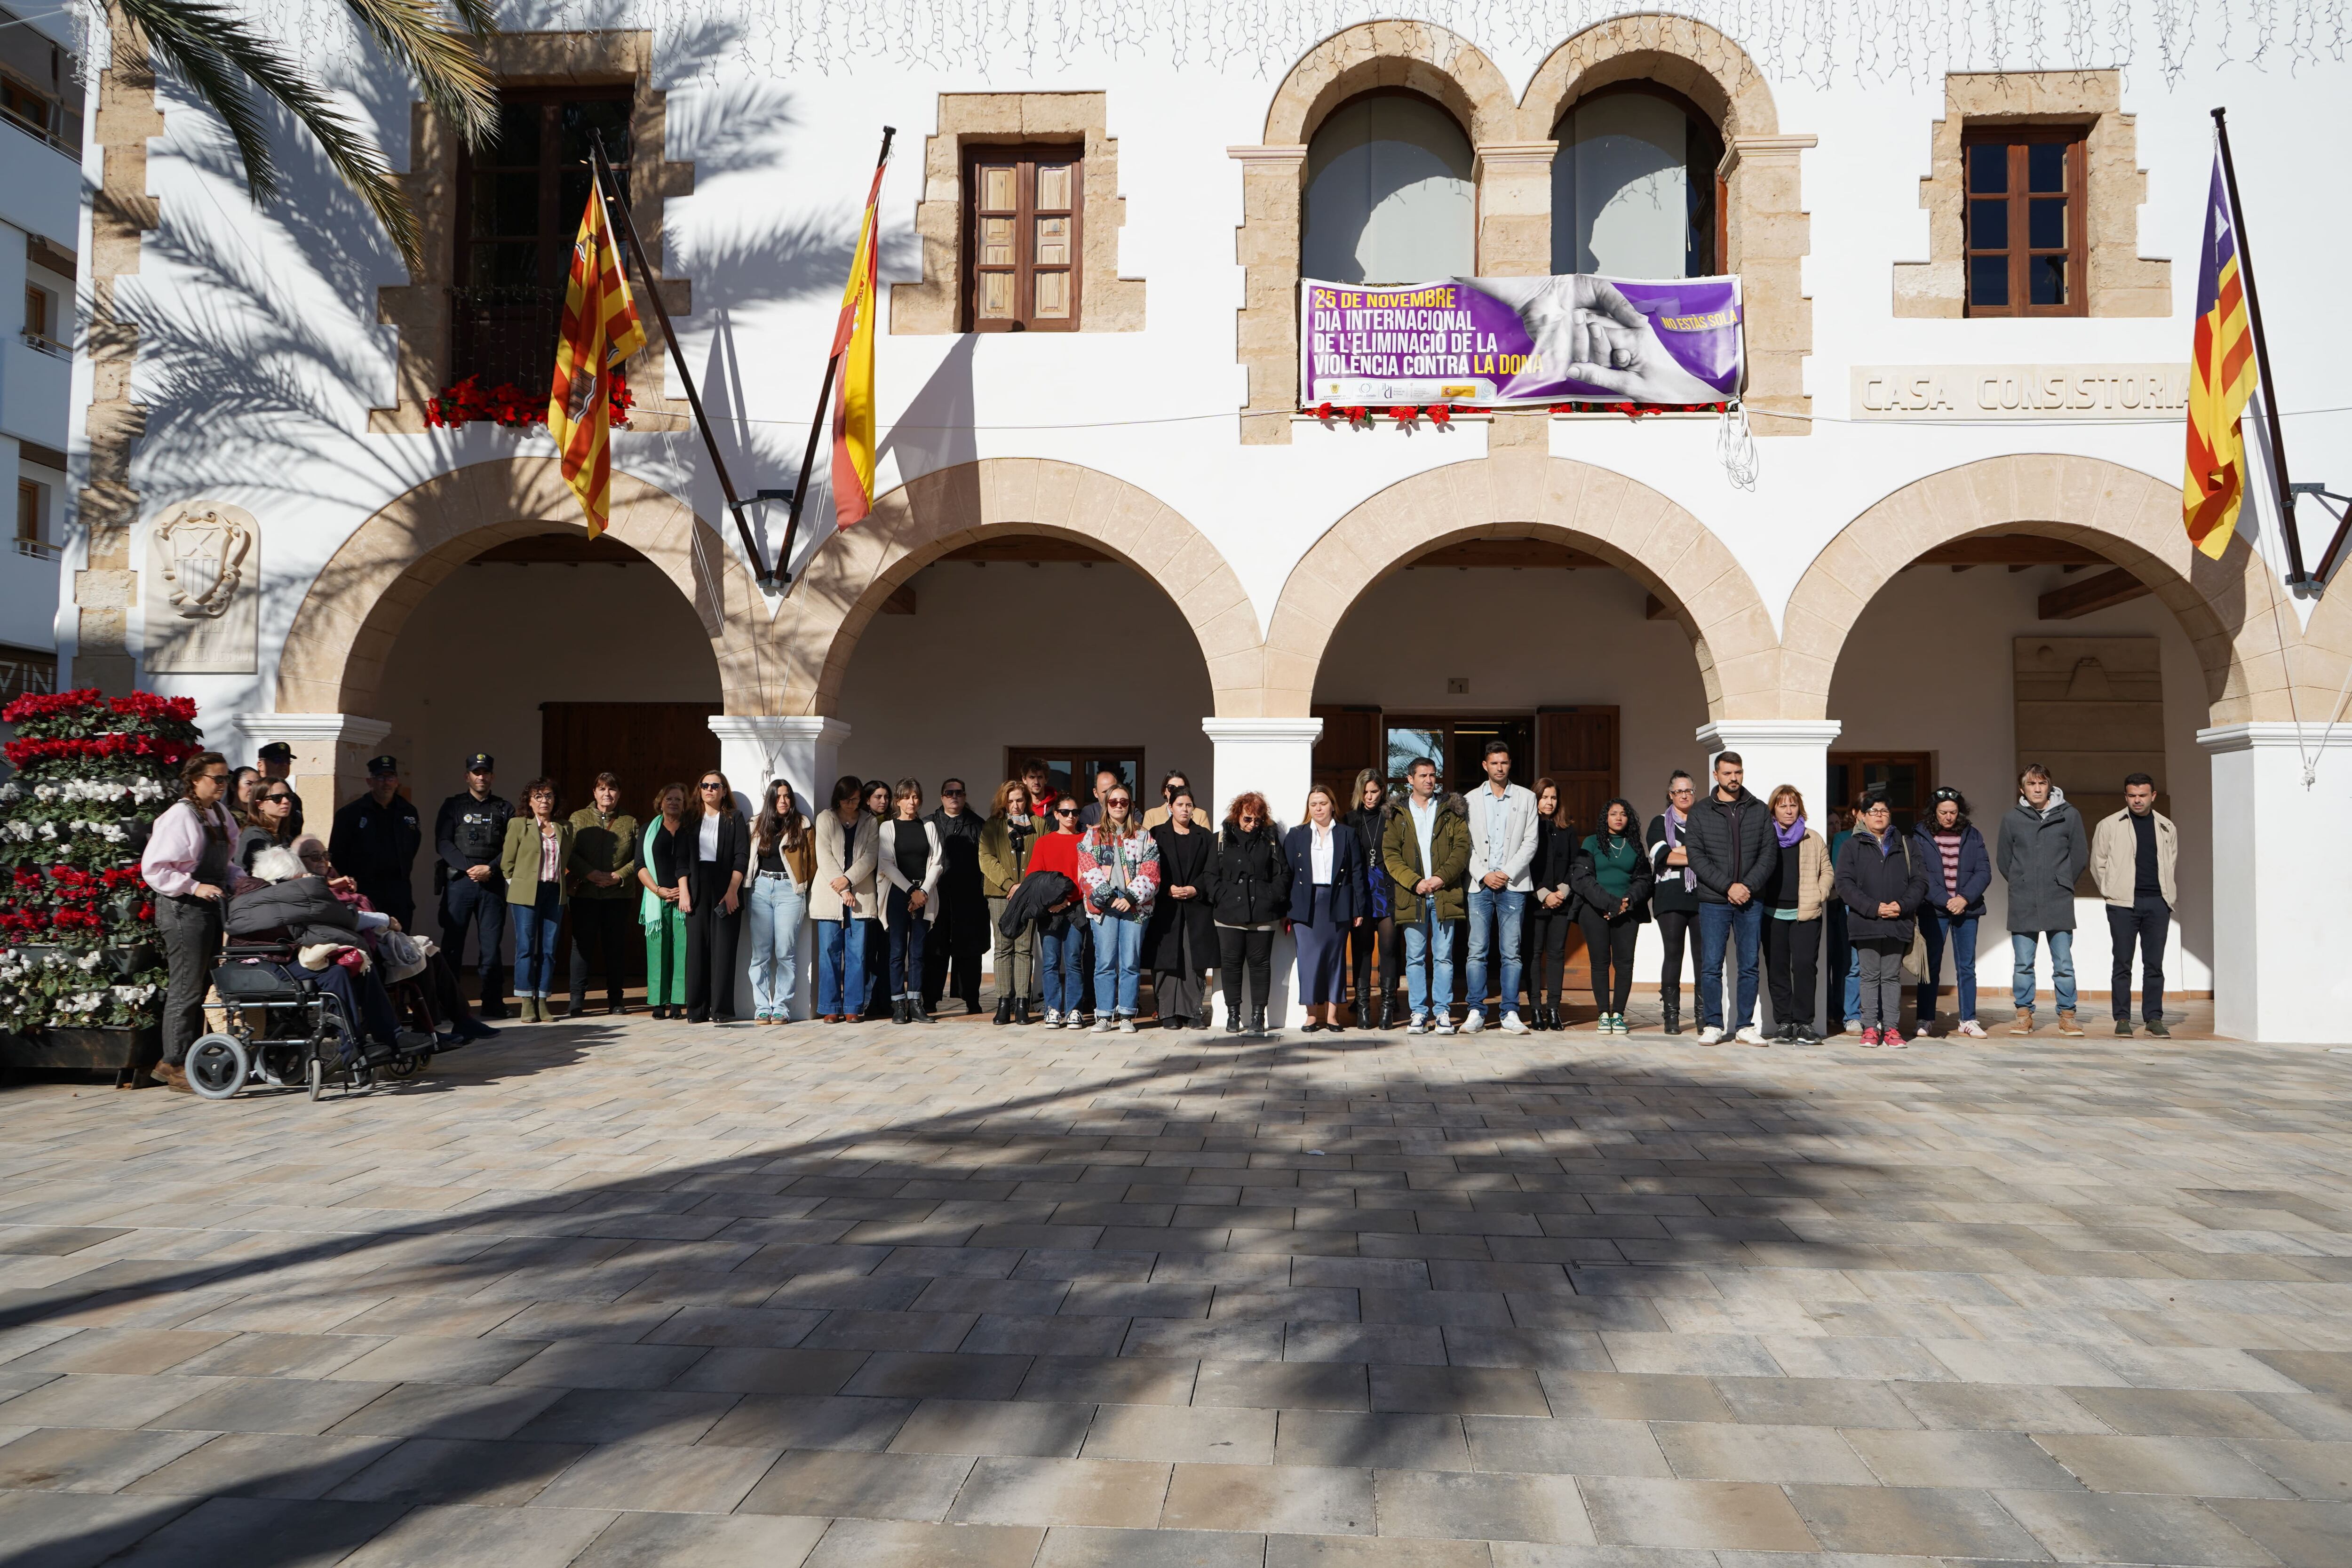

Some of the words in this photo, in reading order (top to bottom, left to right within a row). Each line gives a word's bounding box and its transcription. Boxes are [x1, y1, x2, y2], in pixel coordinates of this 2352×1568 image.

[1315, 288, 1336, 309] 25
[1341, 292, 1362, 309] DE
[1367, 287, 1456, 308] NOVEMBRE
[1314, 310, 1342, 331] DIA
[1346, 309, 1476, 331] INTERNACIONAL
[1661, 317, 1677, 330] NO
[1676, 314, 1708, 330] ESTÀS
[1707, 309, 1738, 327] SOLA
[1314, 333, 1335, 353] DE
[1340, 328, 1446, 354] L'ELIMINACIÓ
[1451, 333, 1472, 353] DE
[1477, 333, 1498, 353] LA
[1313, 351, 1399, 375] VIOLÈNCIA
[1403, 354, 1470, 375] CONTRA
[1474, 354, 1495, 374] LA
[1499, 354, 1543, 375] DONA
[1862, 375, 1954, 411] CASA
[1458, 684, 1462, 692] 1
